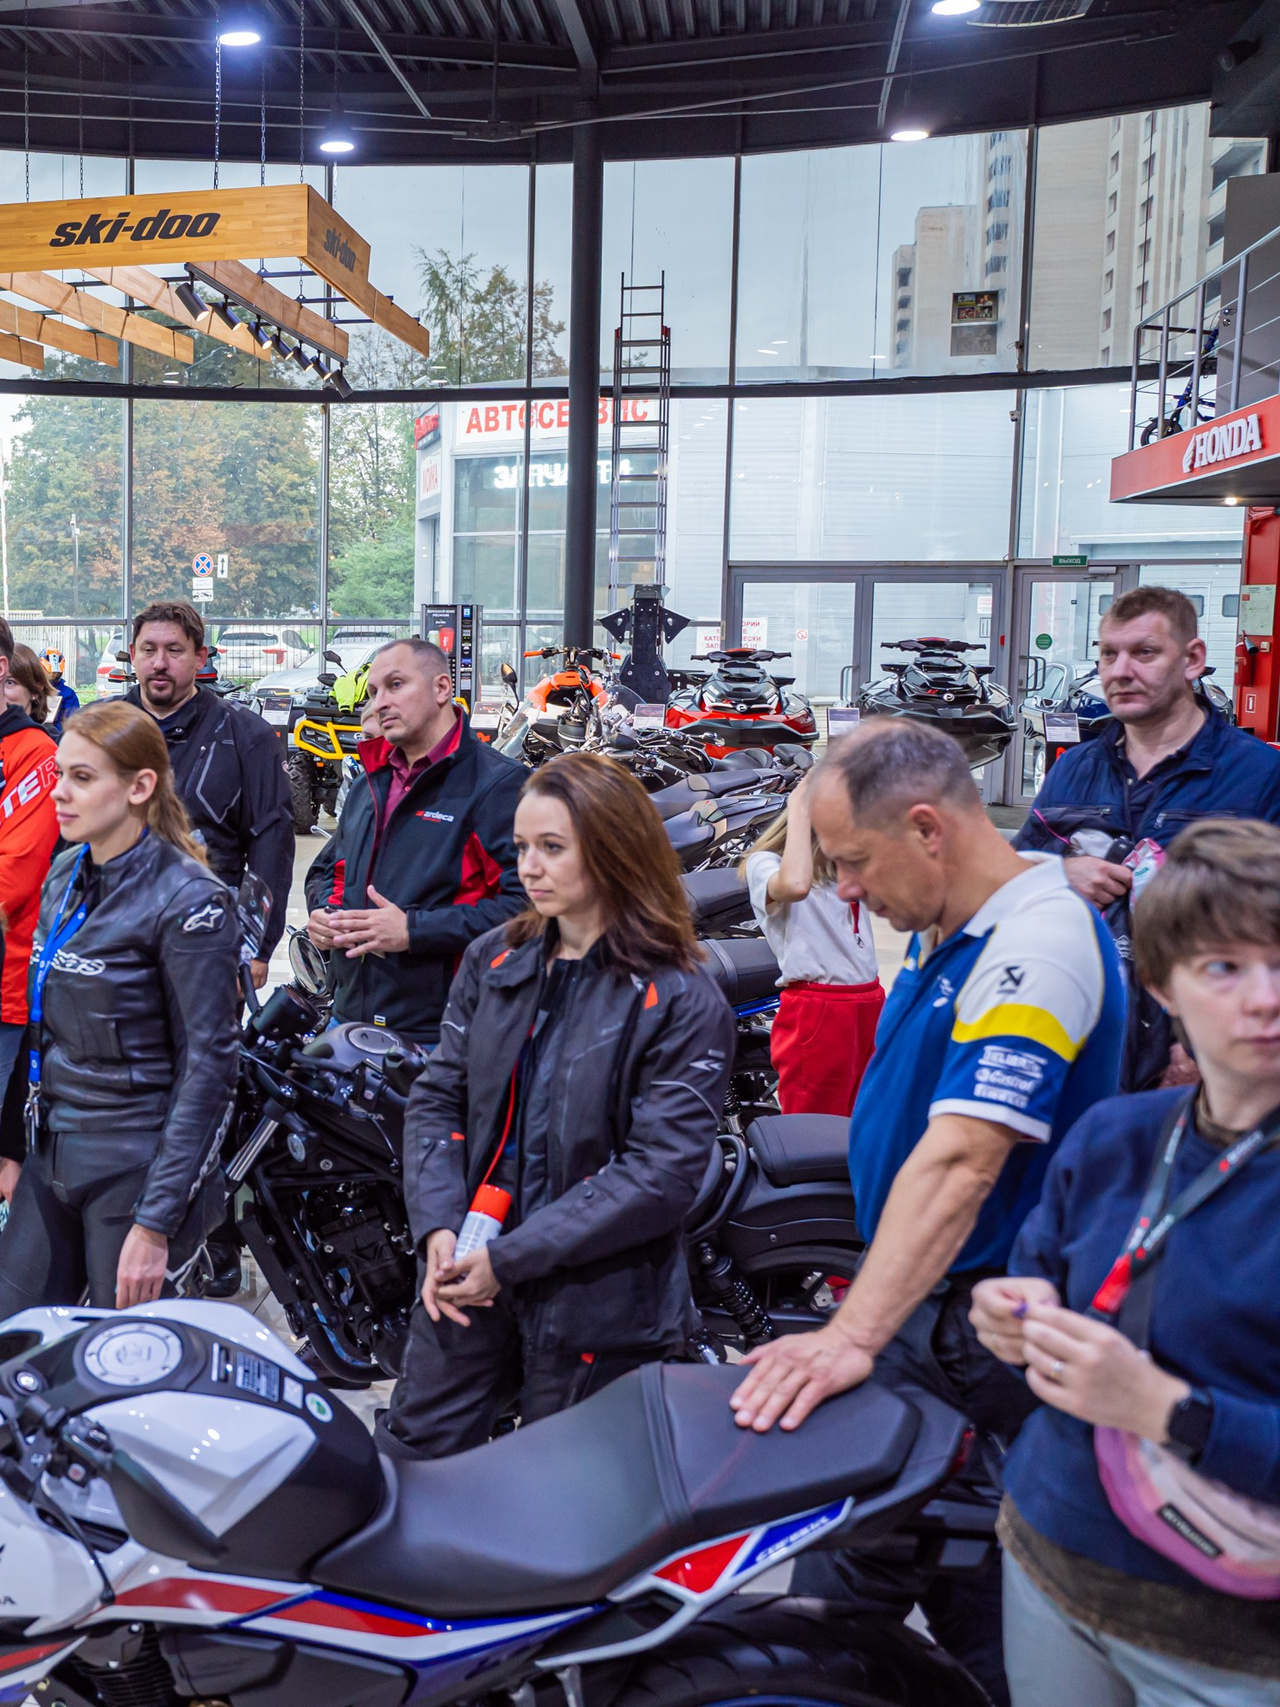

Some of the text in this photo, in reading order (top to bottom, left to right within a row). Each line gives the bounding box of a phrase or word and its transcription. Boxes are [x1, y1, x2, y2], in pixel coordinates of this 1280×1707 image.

[49, 209, 221, 247] ski-doo
[466, 396, 650, 434] АВТОСЕВИС
[1193, 413, 1263, 469] HONDA
